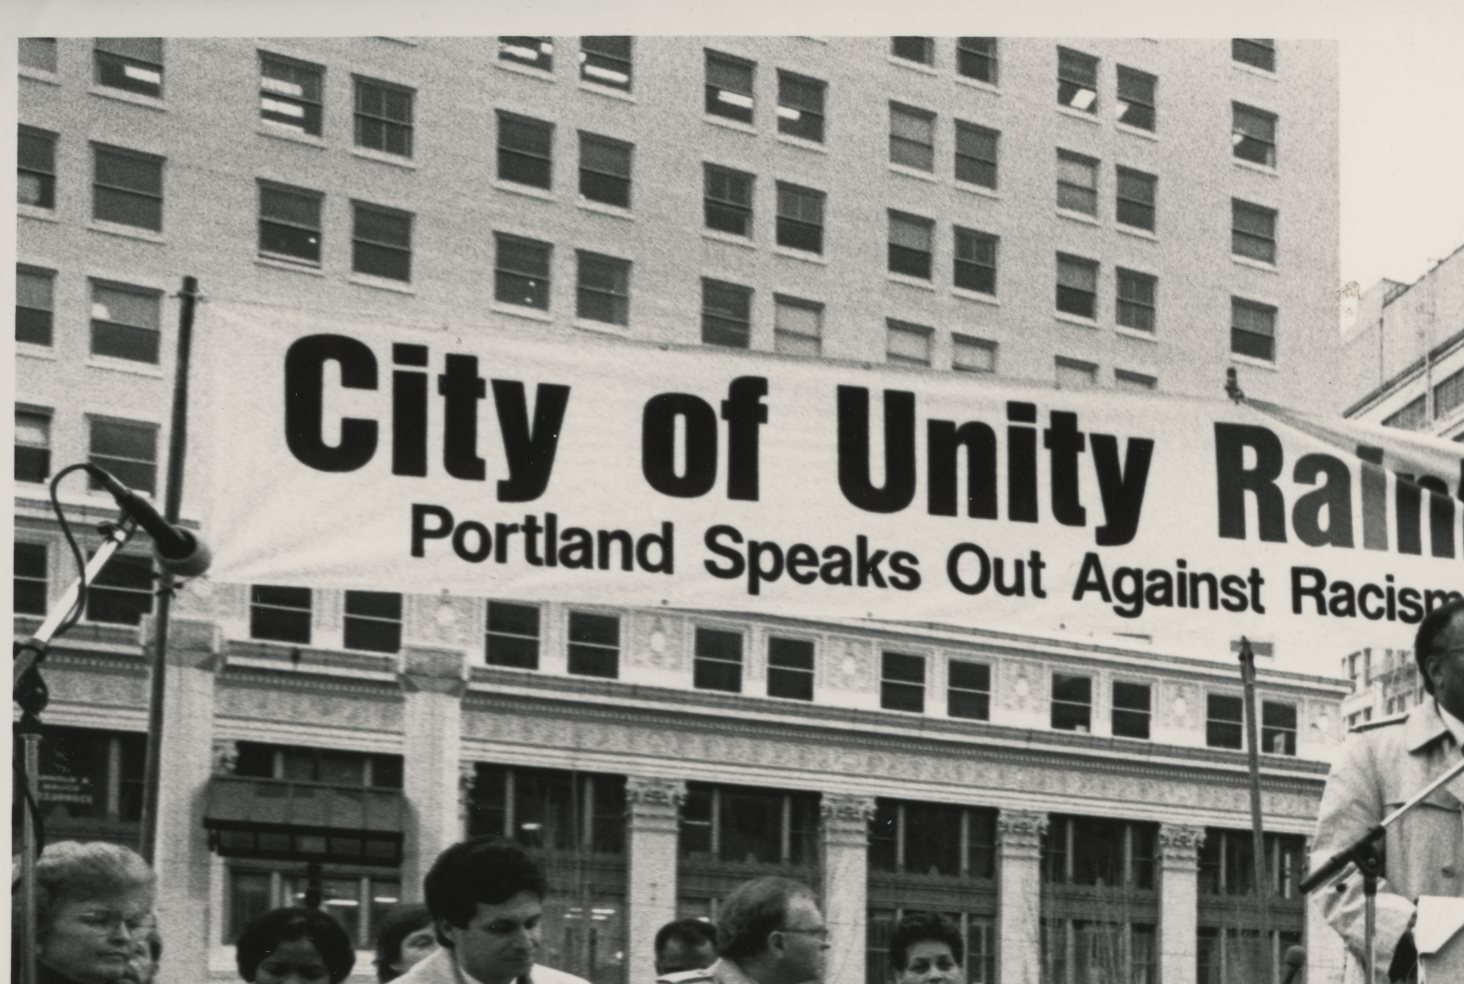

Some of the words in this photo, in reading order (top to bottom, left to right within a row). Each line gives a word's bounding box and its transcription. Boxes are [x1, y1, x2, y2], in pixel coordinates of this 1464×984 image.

[284, 333, 571, 503] City
[641, 376, 769, 502] of
[836, 384, 1155, 547] Unity
[410, 503, 674, 575] Portland
[703, 524, 921, 596] Speaks
[947, 542, 1046, 599] Out
[1072, 552, 1265, 619] Against
